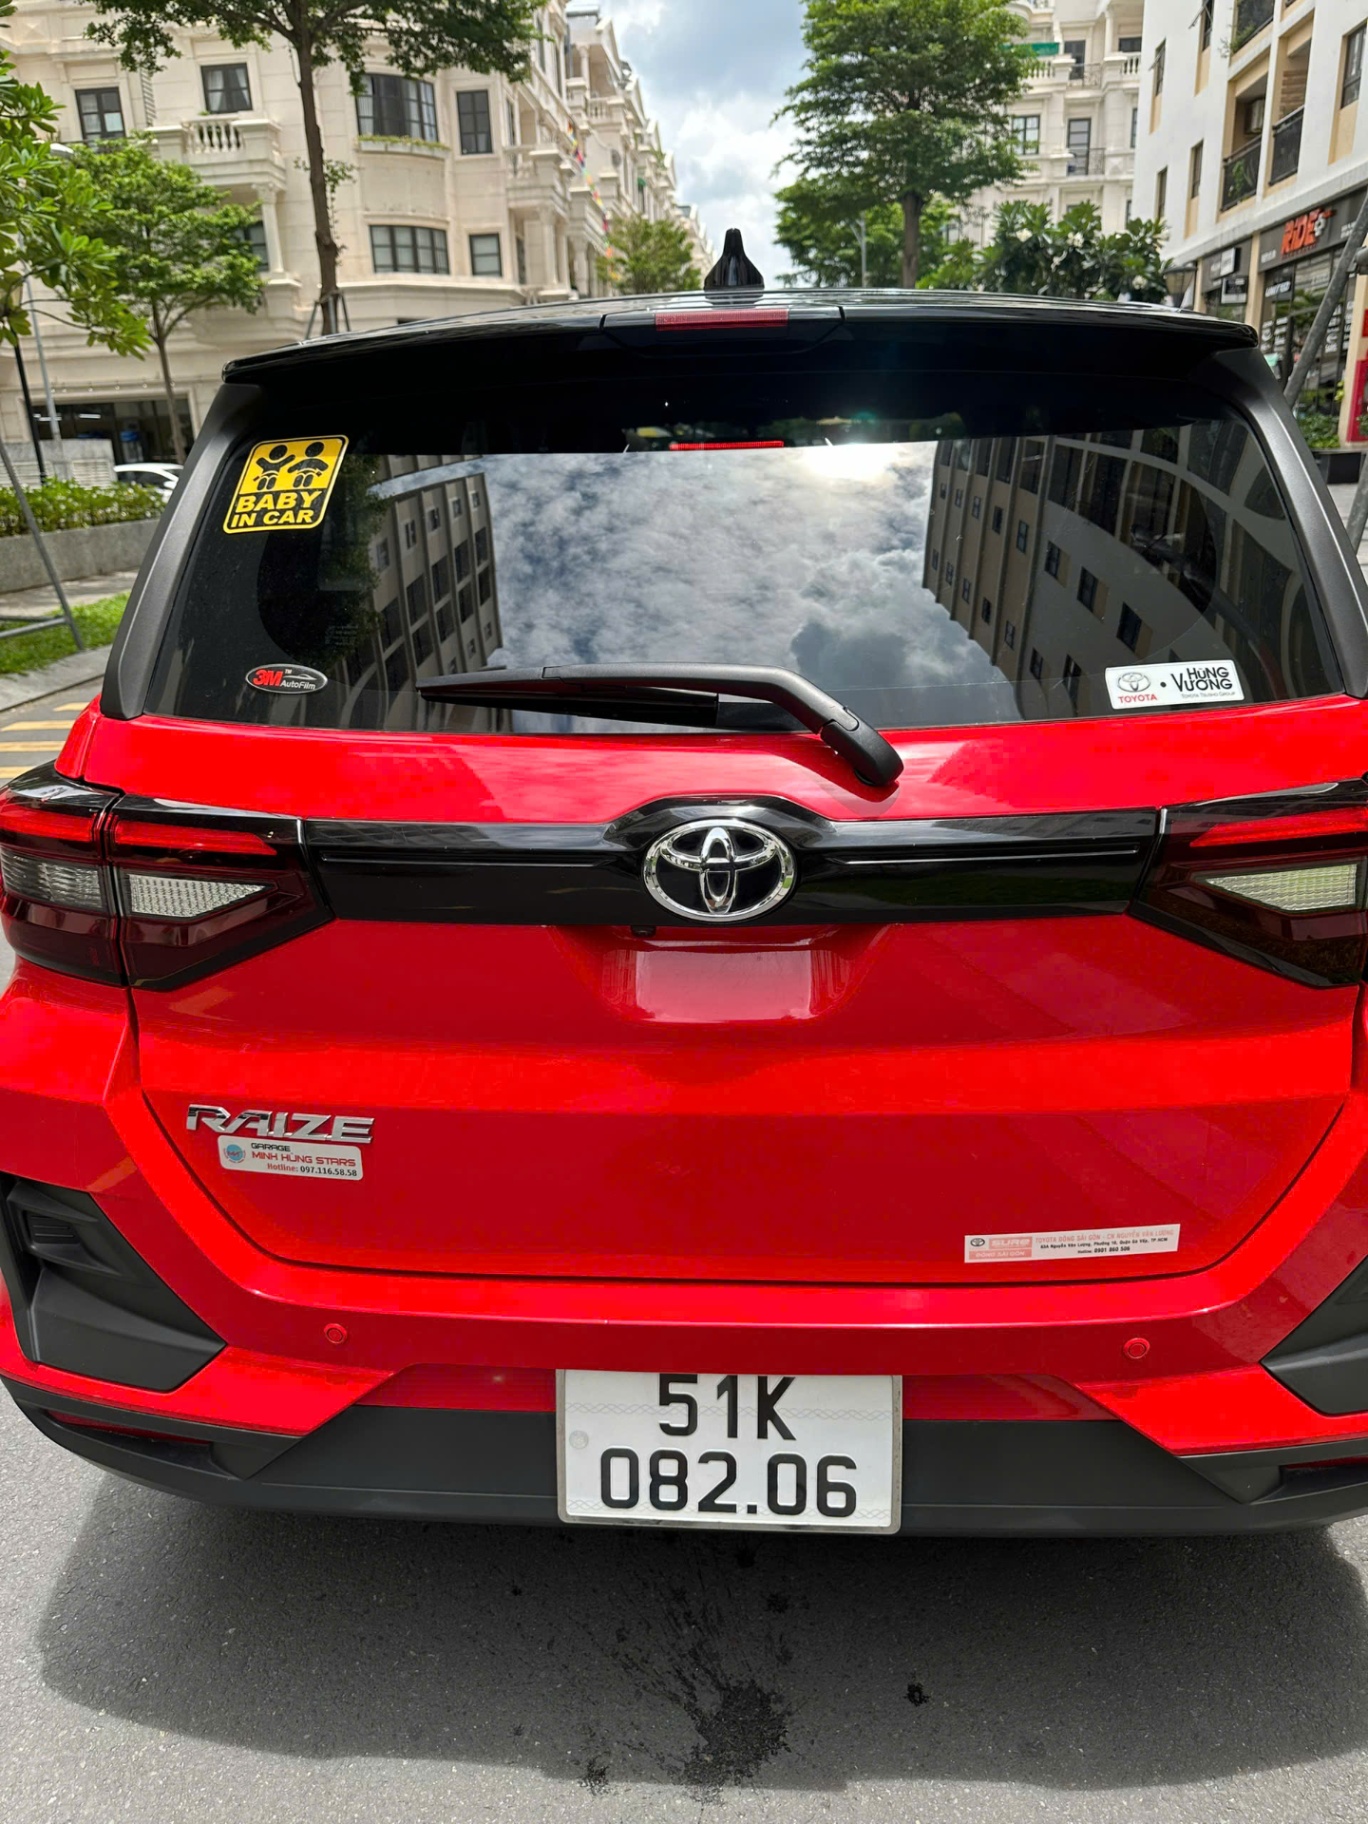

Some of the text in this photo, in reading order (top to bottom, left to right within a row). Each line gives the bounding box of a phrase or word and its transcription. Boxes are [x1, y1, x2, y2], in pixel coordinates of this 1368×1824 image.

[235, 491, 322, 513] BABY
[230, 509, 314, 528] IN CAR
[252, 669, 283, 687] 3M
[280, 680, 316, 690] AutoFilm
[1118, 694, 1158, 704] TOYOTA
[186, 1104, 375, 1144] RAIZE
[251, 1142, 291, 1152] GARAGE
[251, 1151, 278, 1161] MINH
[315, 1157, 356, 1167] STARS
[267, 1163, 357, 1177] Hotline: 097.116.58.58
[658, 1373, 797, 1441] 51K
[600, 1447, 857, 1518] 082.06
